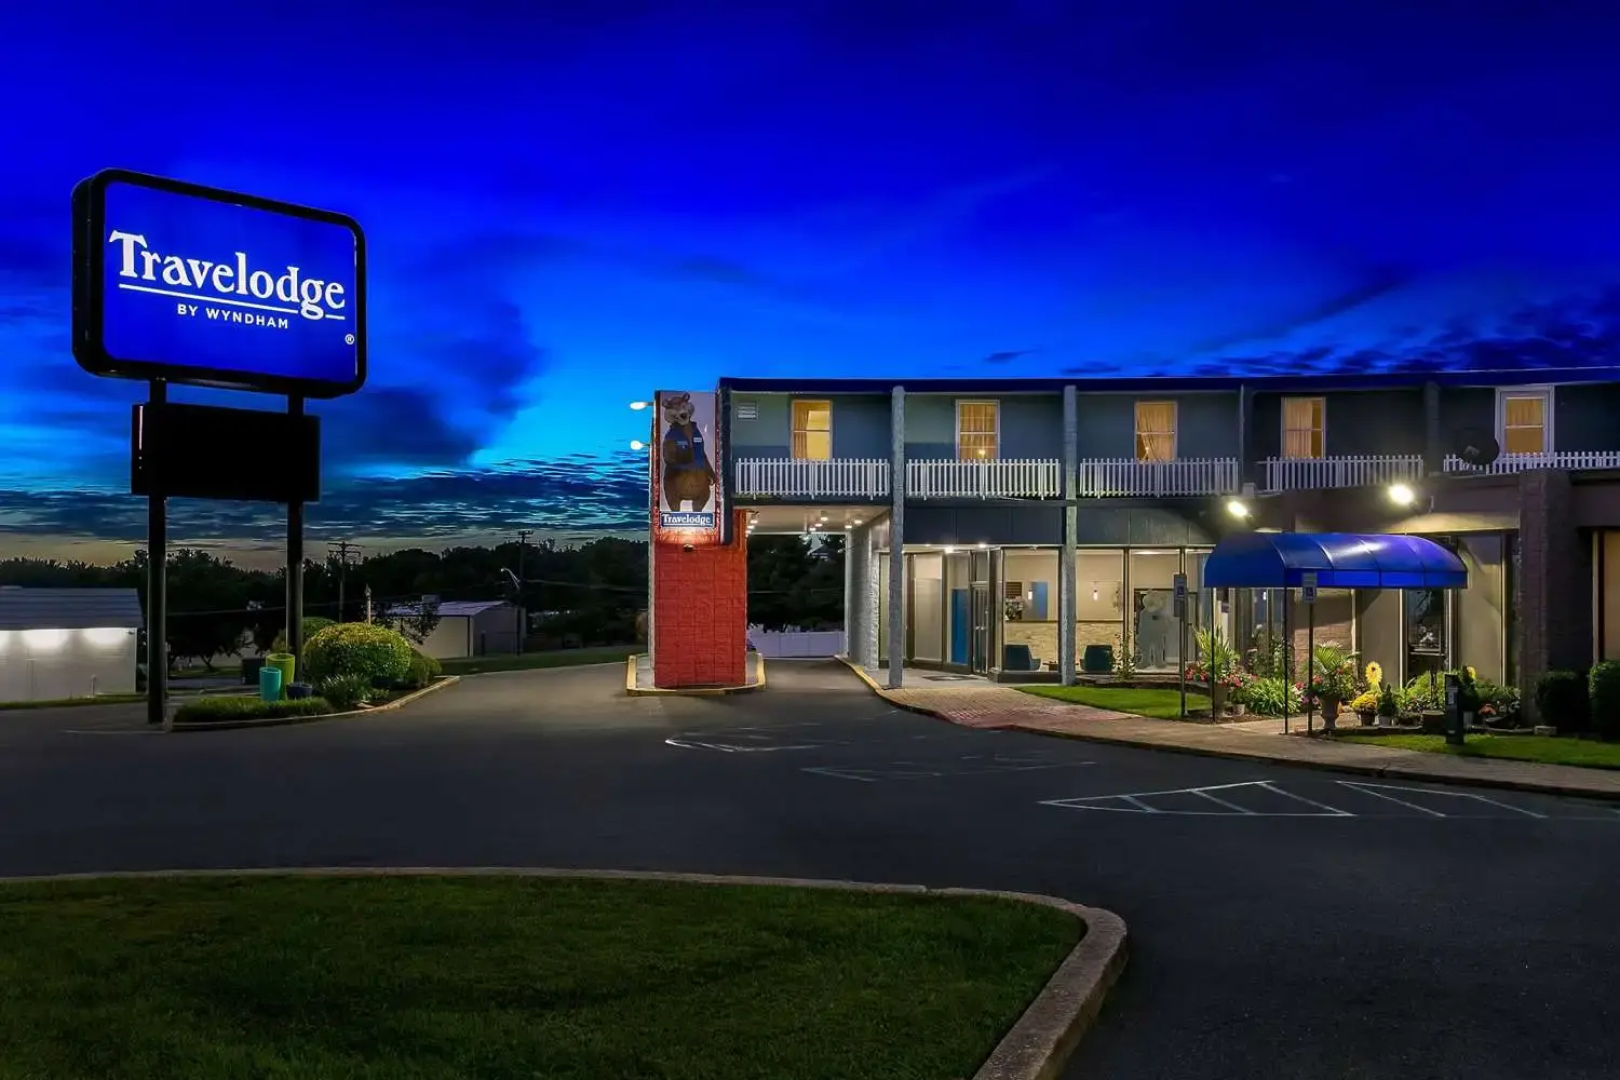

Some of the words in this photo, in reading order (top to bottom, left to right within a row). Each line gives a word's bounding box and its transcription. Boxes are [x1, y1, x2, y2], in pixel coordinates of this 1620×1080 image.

[109, 230, 345, 320] Travelodge
[177, 303, 198, 316] BY
[206, 307, 289, 329] WYNDHAM
[661, 513, 711, 526] Travelodge
